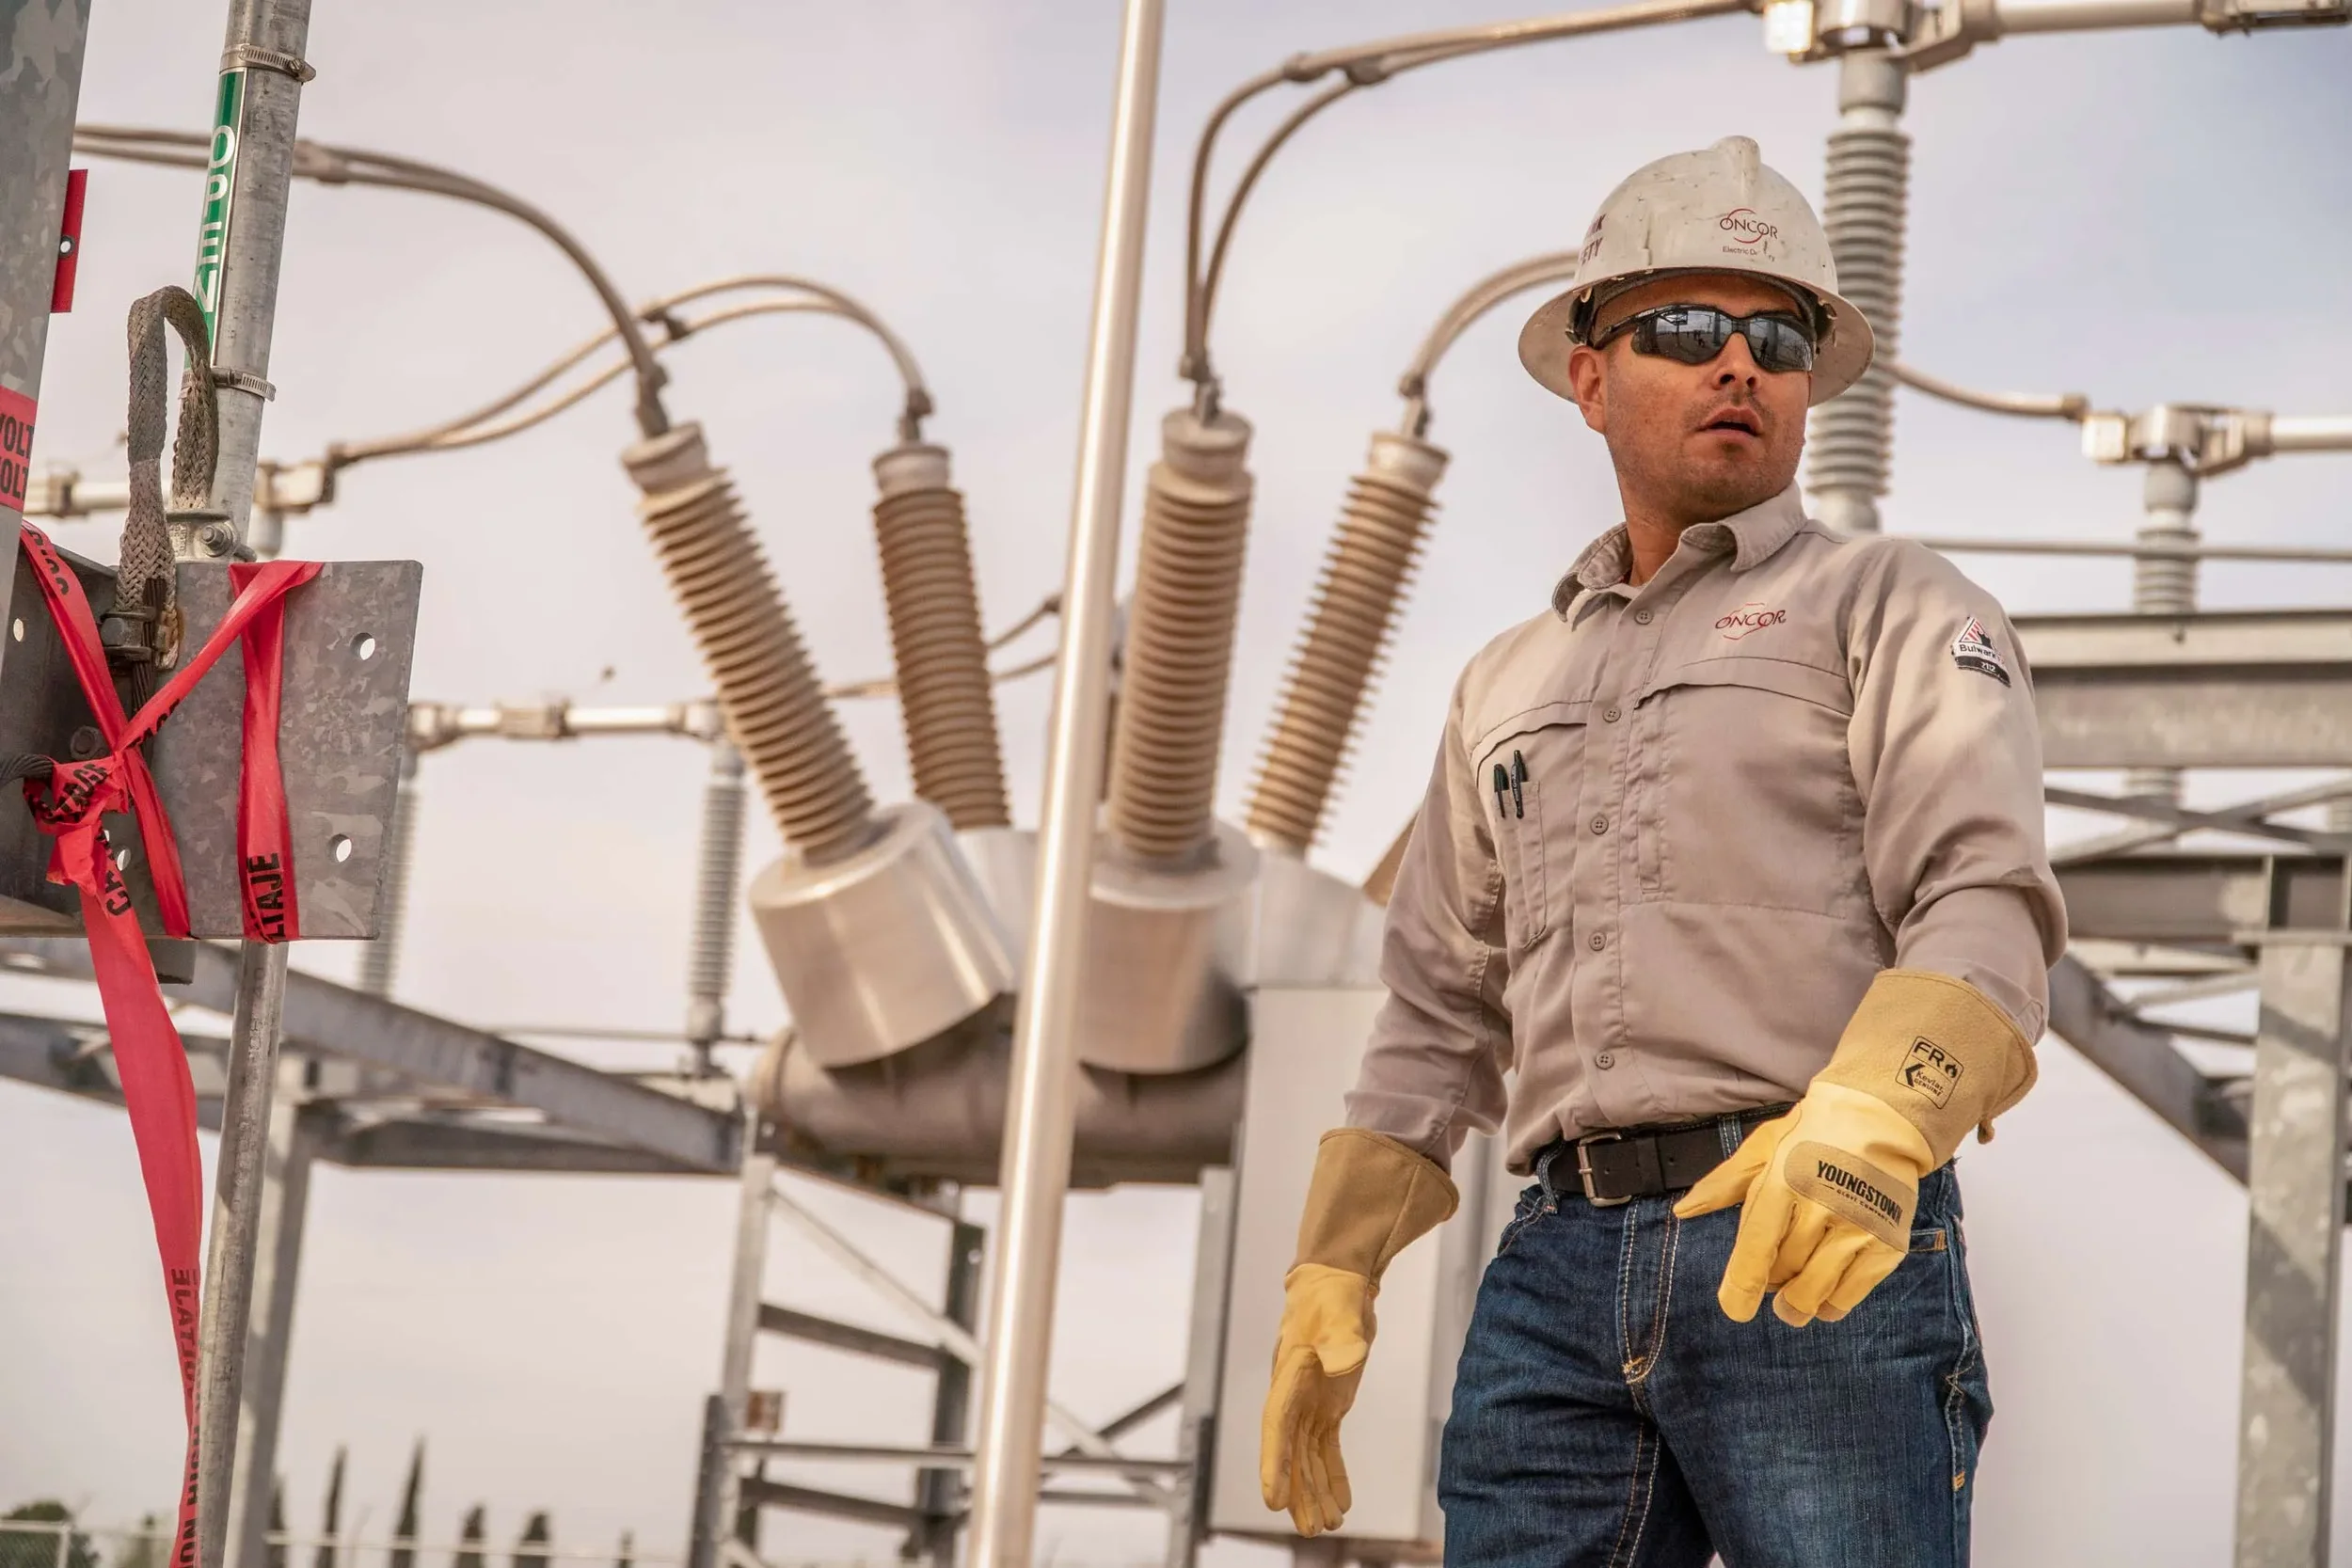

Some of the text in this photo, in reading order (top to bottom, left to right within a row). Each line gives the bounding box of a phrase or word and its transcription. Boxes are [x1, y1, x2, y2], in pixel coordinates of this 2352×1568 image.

[196, 125, 235, 312] OPEN
[1720, 217, 1778, 240] ONCOR
[1723, 245, 1749, 256] Electric
[1715, 610, 1787, 629] ONCOR
[1960, 644, 1996, 658] Bulwark
[1914, 1041, 1945, 1068] FR
[1817, 1160, 1903, 1227] YOUNGSTOWN
